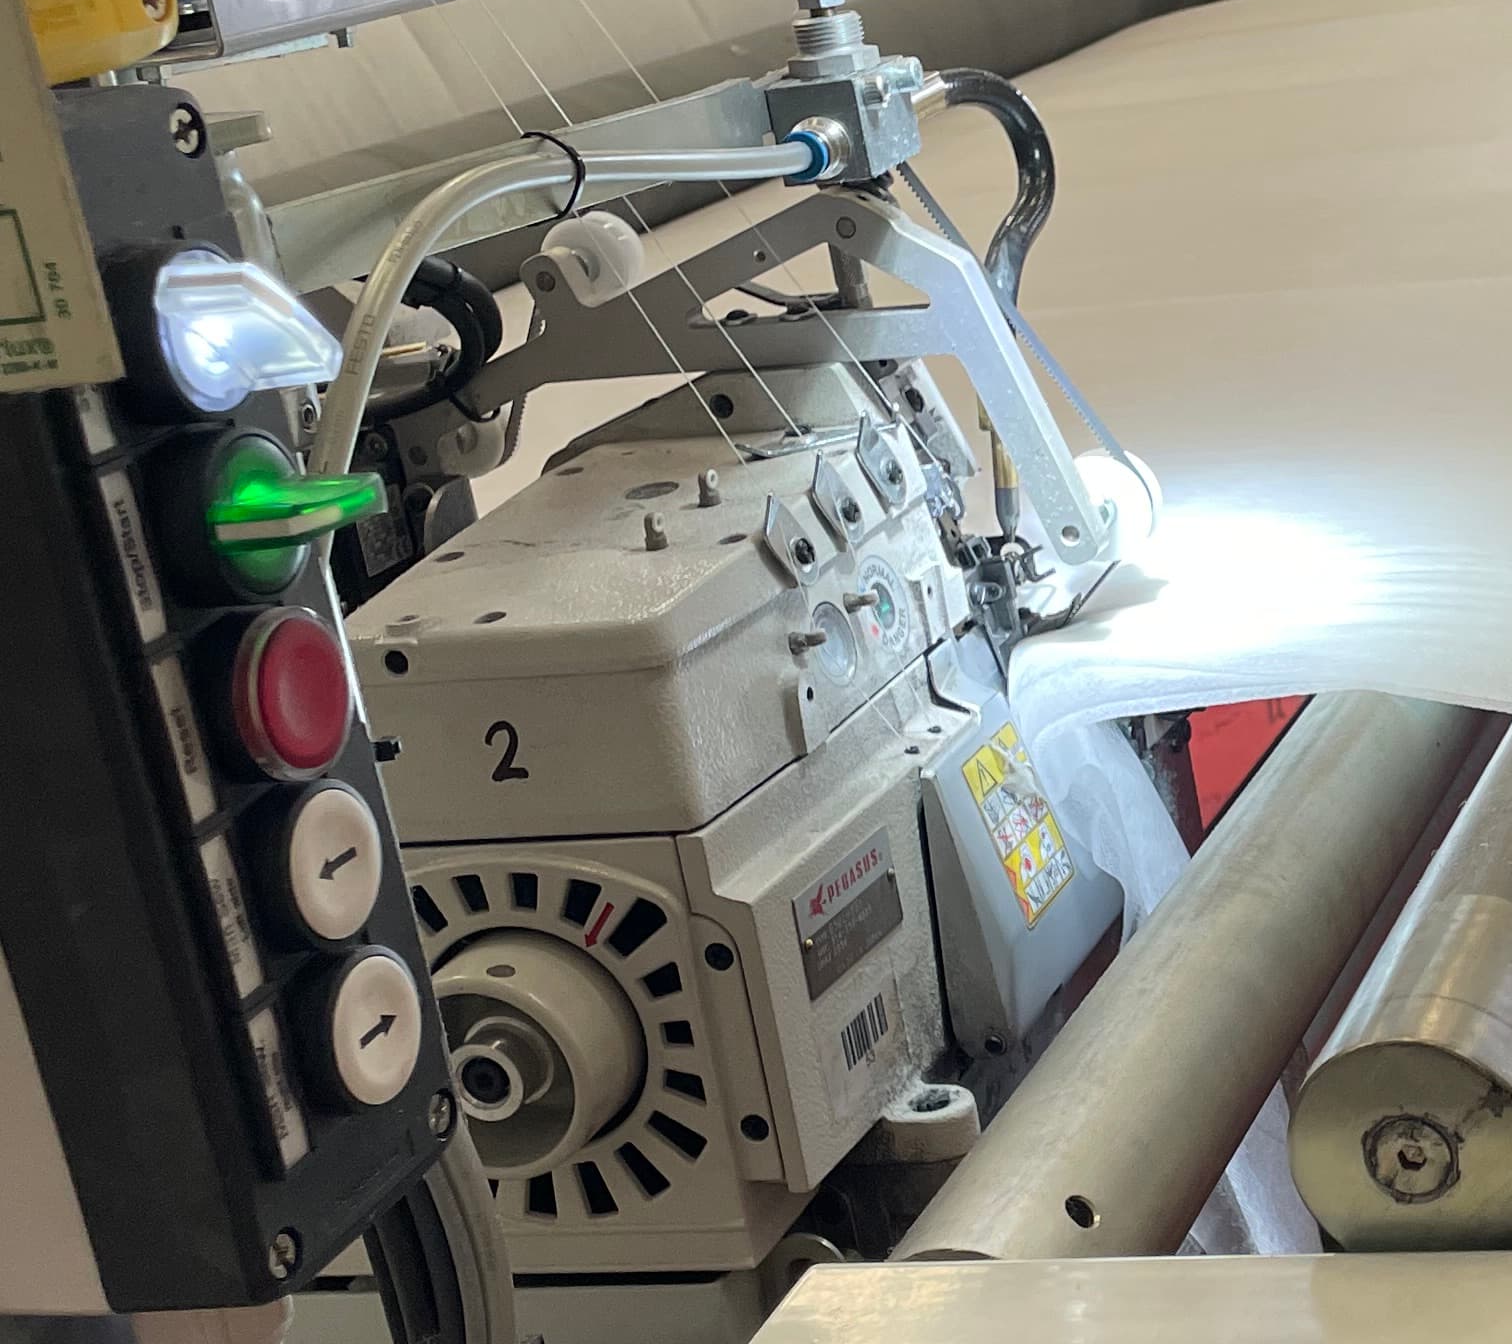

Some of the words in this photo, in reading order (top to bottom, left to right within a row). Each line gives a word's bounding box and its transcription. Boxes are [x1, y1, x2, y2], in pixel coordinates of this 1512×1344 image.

[113, 499, 155, 612] Stop/Start
[863, 564, 896, 593] NORMAL
[881, 608, 906, 646] DANGER
[170, 707, 198, 775] Reset
[484, 720, 529, 783] 2
[826, 848, 880, 904] PEGASUS
